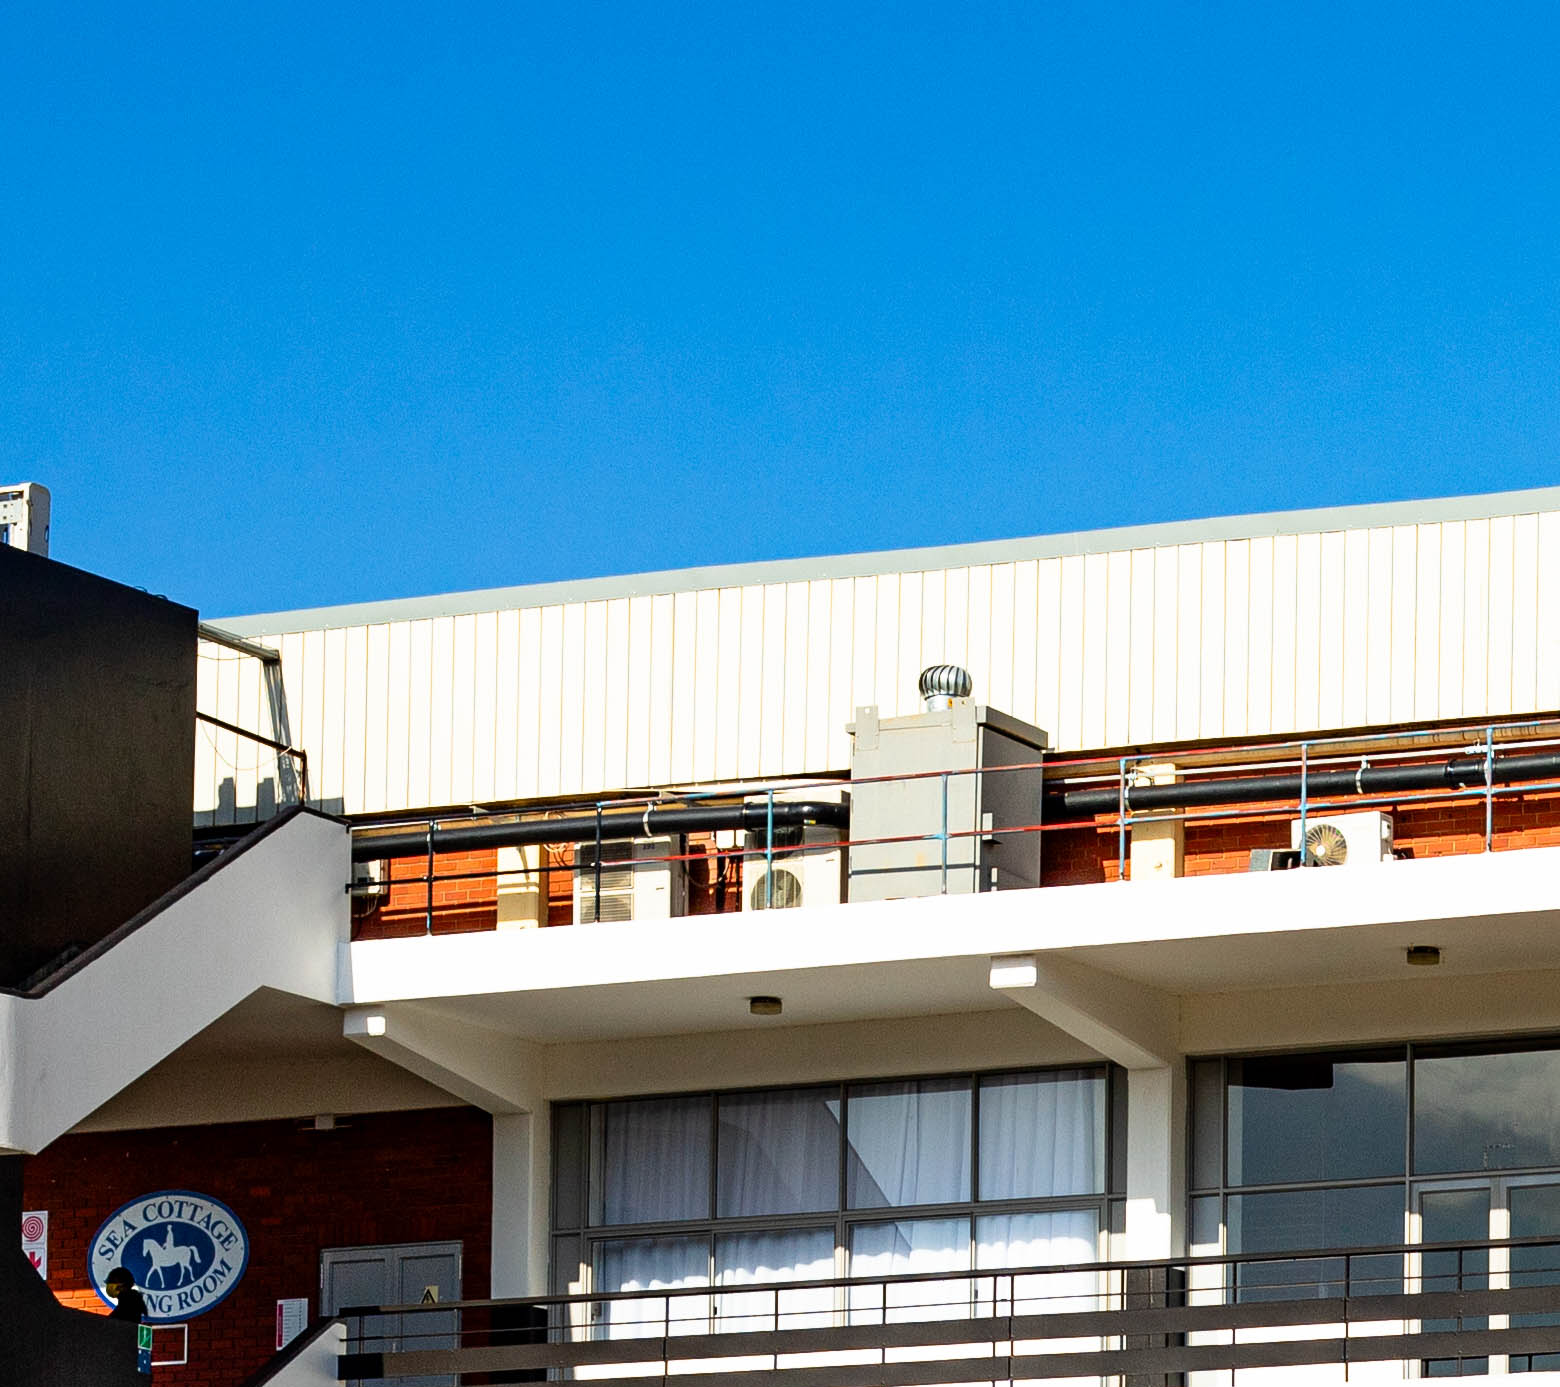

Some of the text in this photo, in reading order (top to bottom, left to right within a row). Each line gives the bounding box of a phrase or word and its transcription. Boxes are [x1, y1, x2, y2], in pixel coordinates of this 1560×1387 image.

[99, 1200, 238, 1261] SEA COTTAGE
[177, 1259, 232, 1311] ROOM
